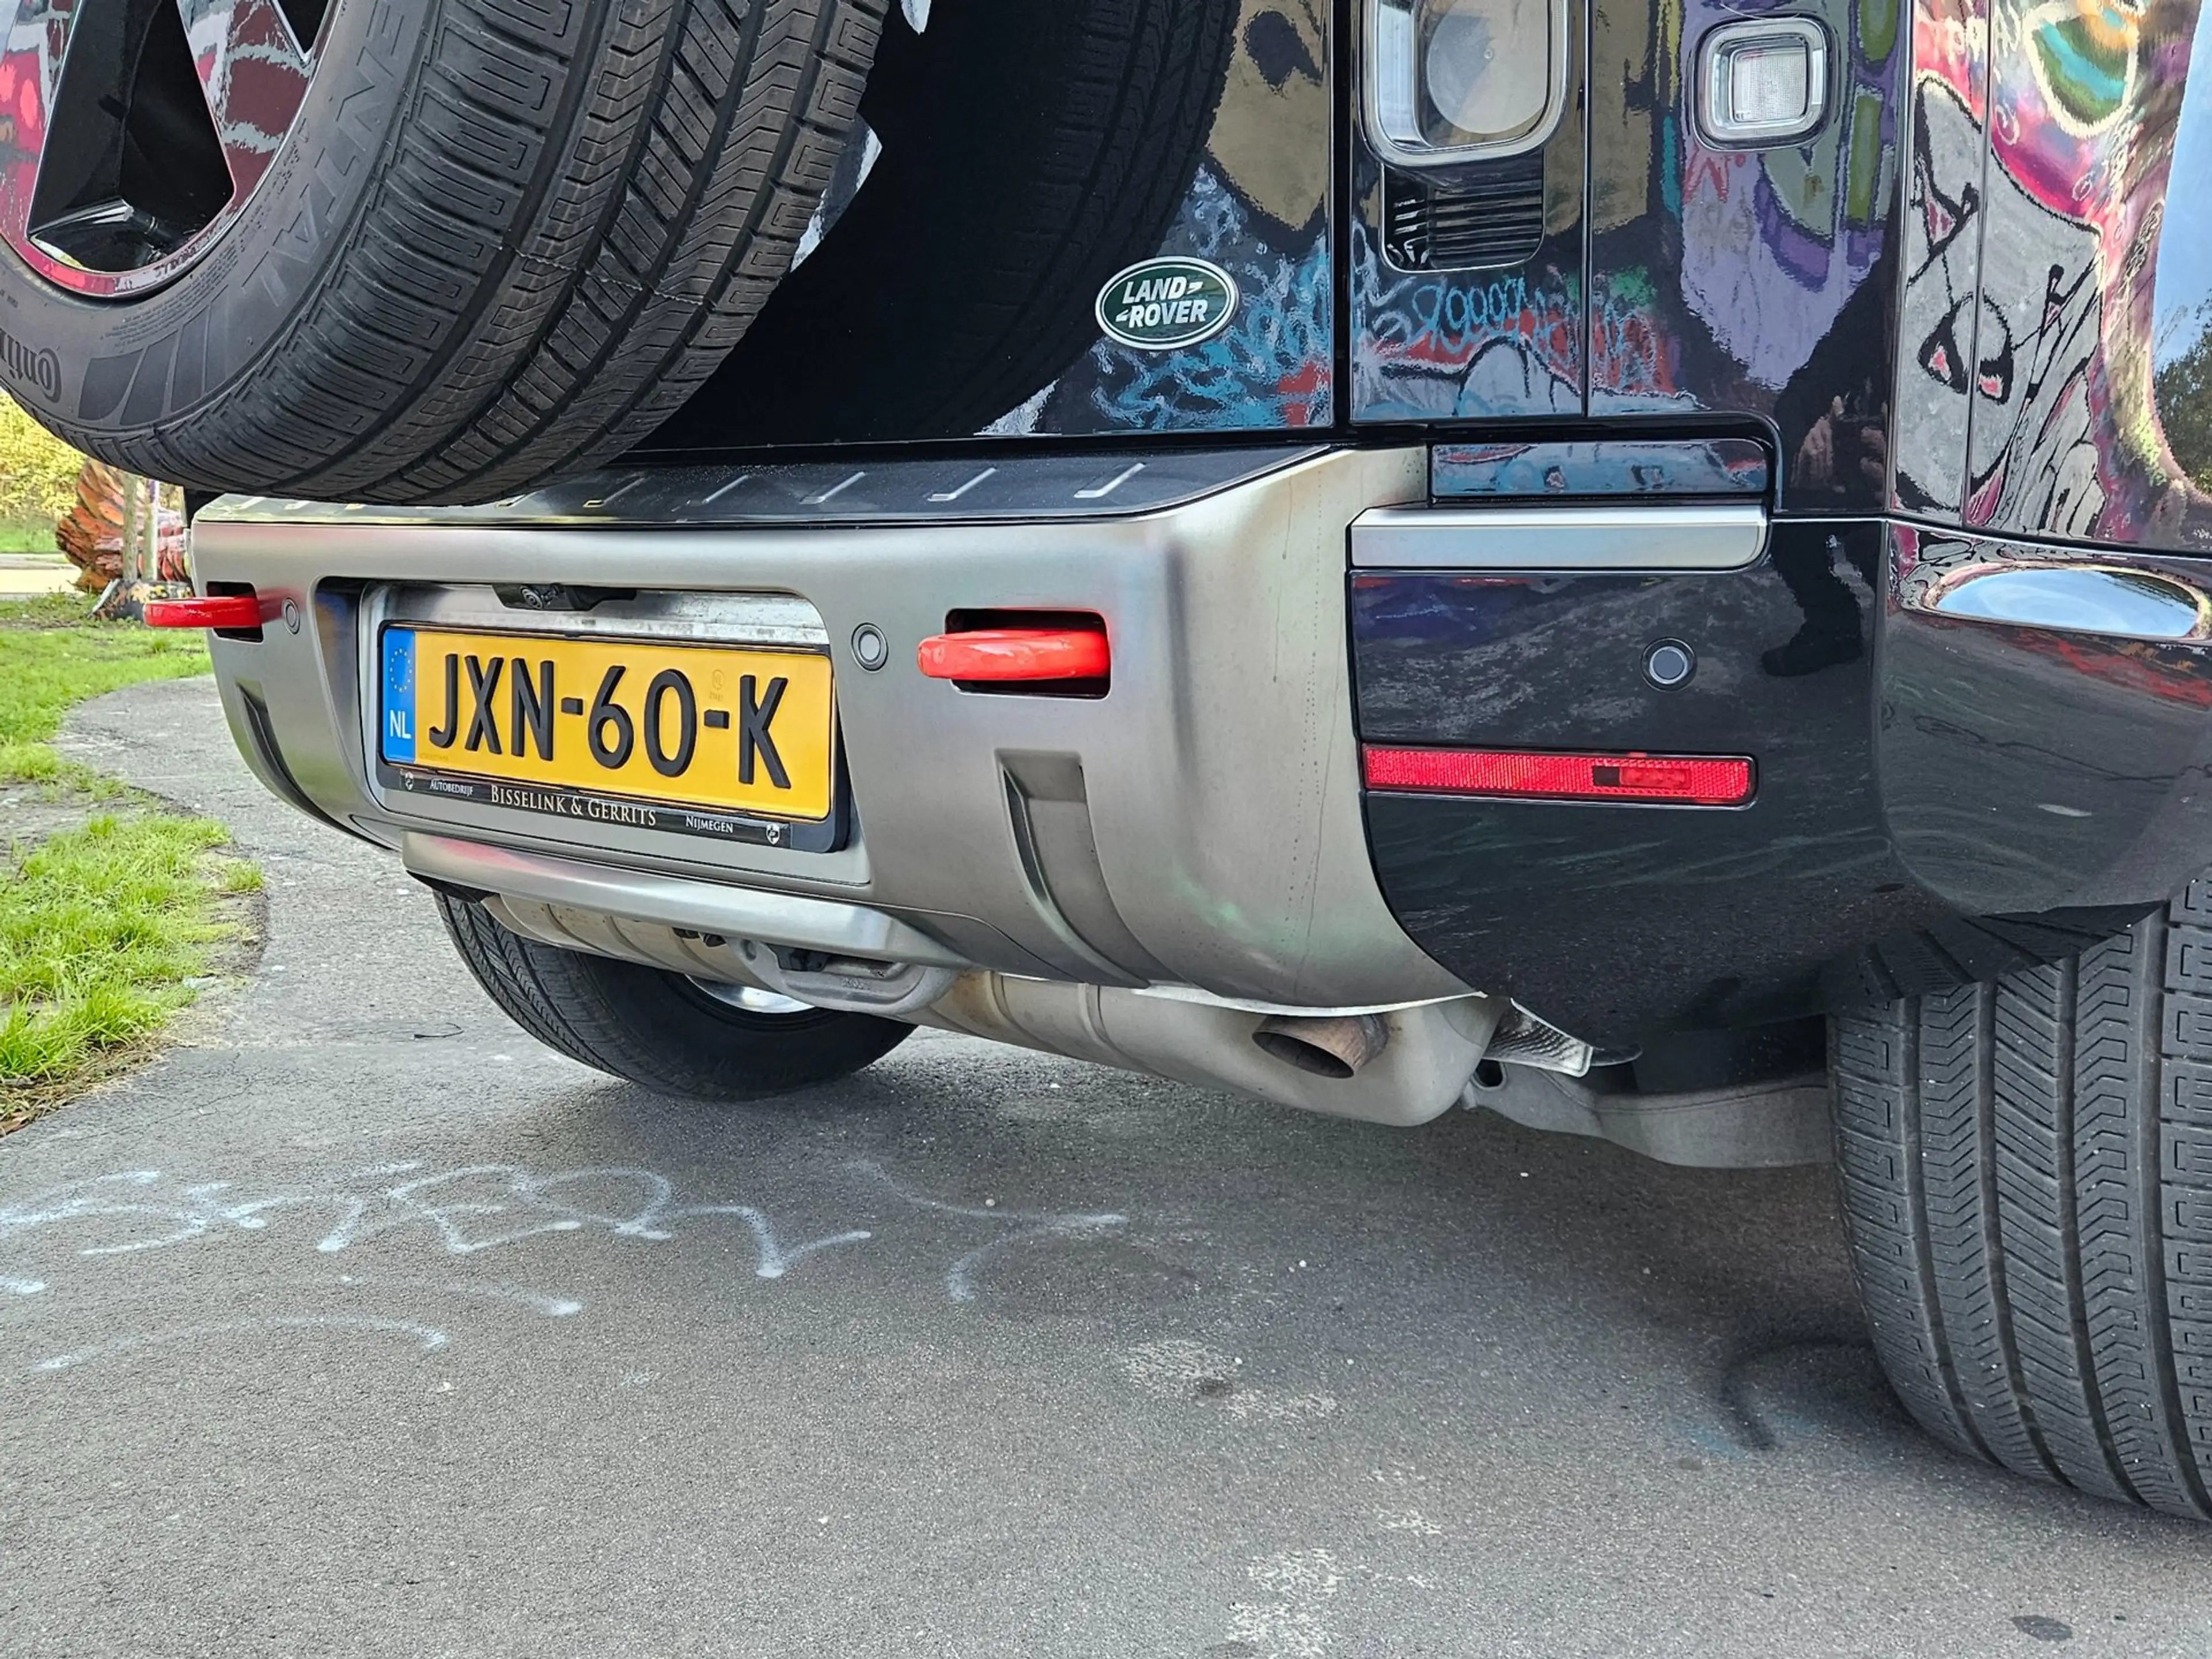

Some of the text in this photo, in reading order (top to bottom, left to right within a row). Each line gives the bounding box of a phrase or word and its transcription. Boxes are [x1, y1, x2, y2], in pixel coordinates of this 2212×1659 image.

[389, 709, 411, 739] NL
[429, 653, 791, 789] JXN-60-K
[430, 779, 734, 834] AUTOBEDRIJF BISSELINK & GERRITS NIJMEGEN
